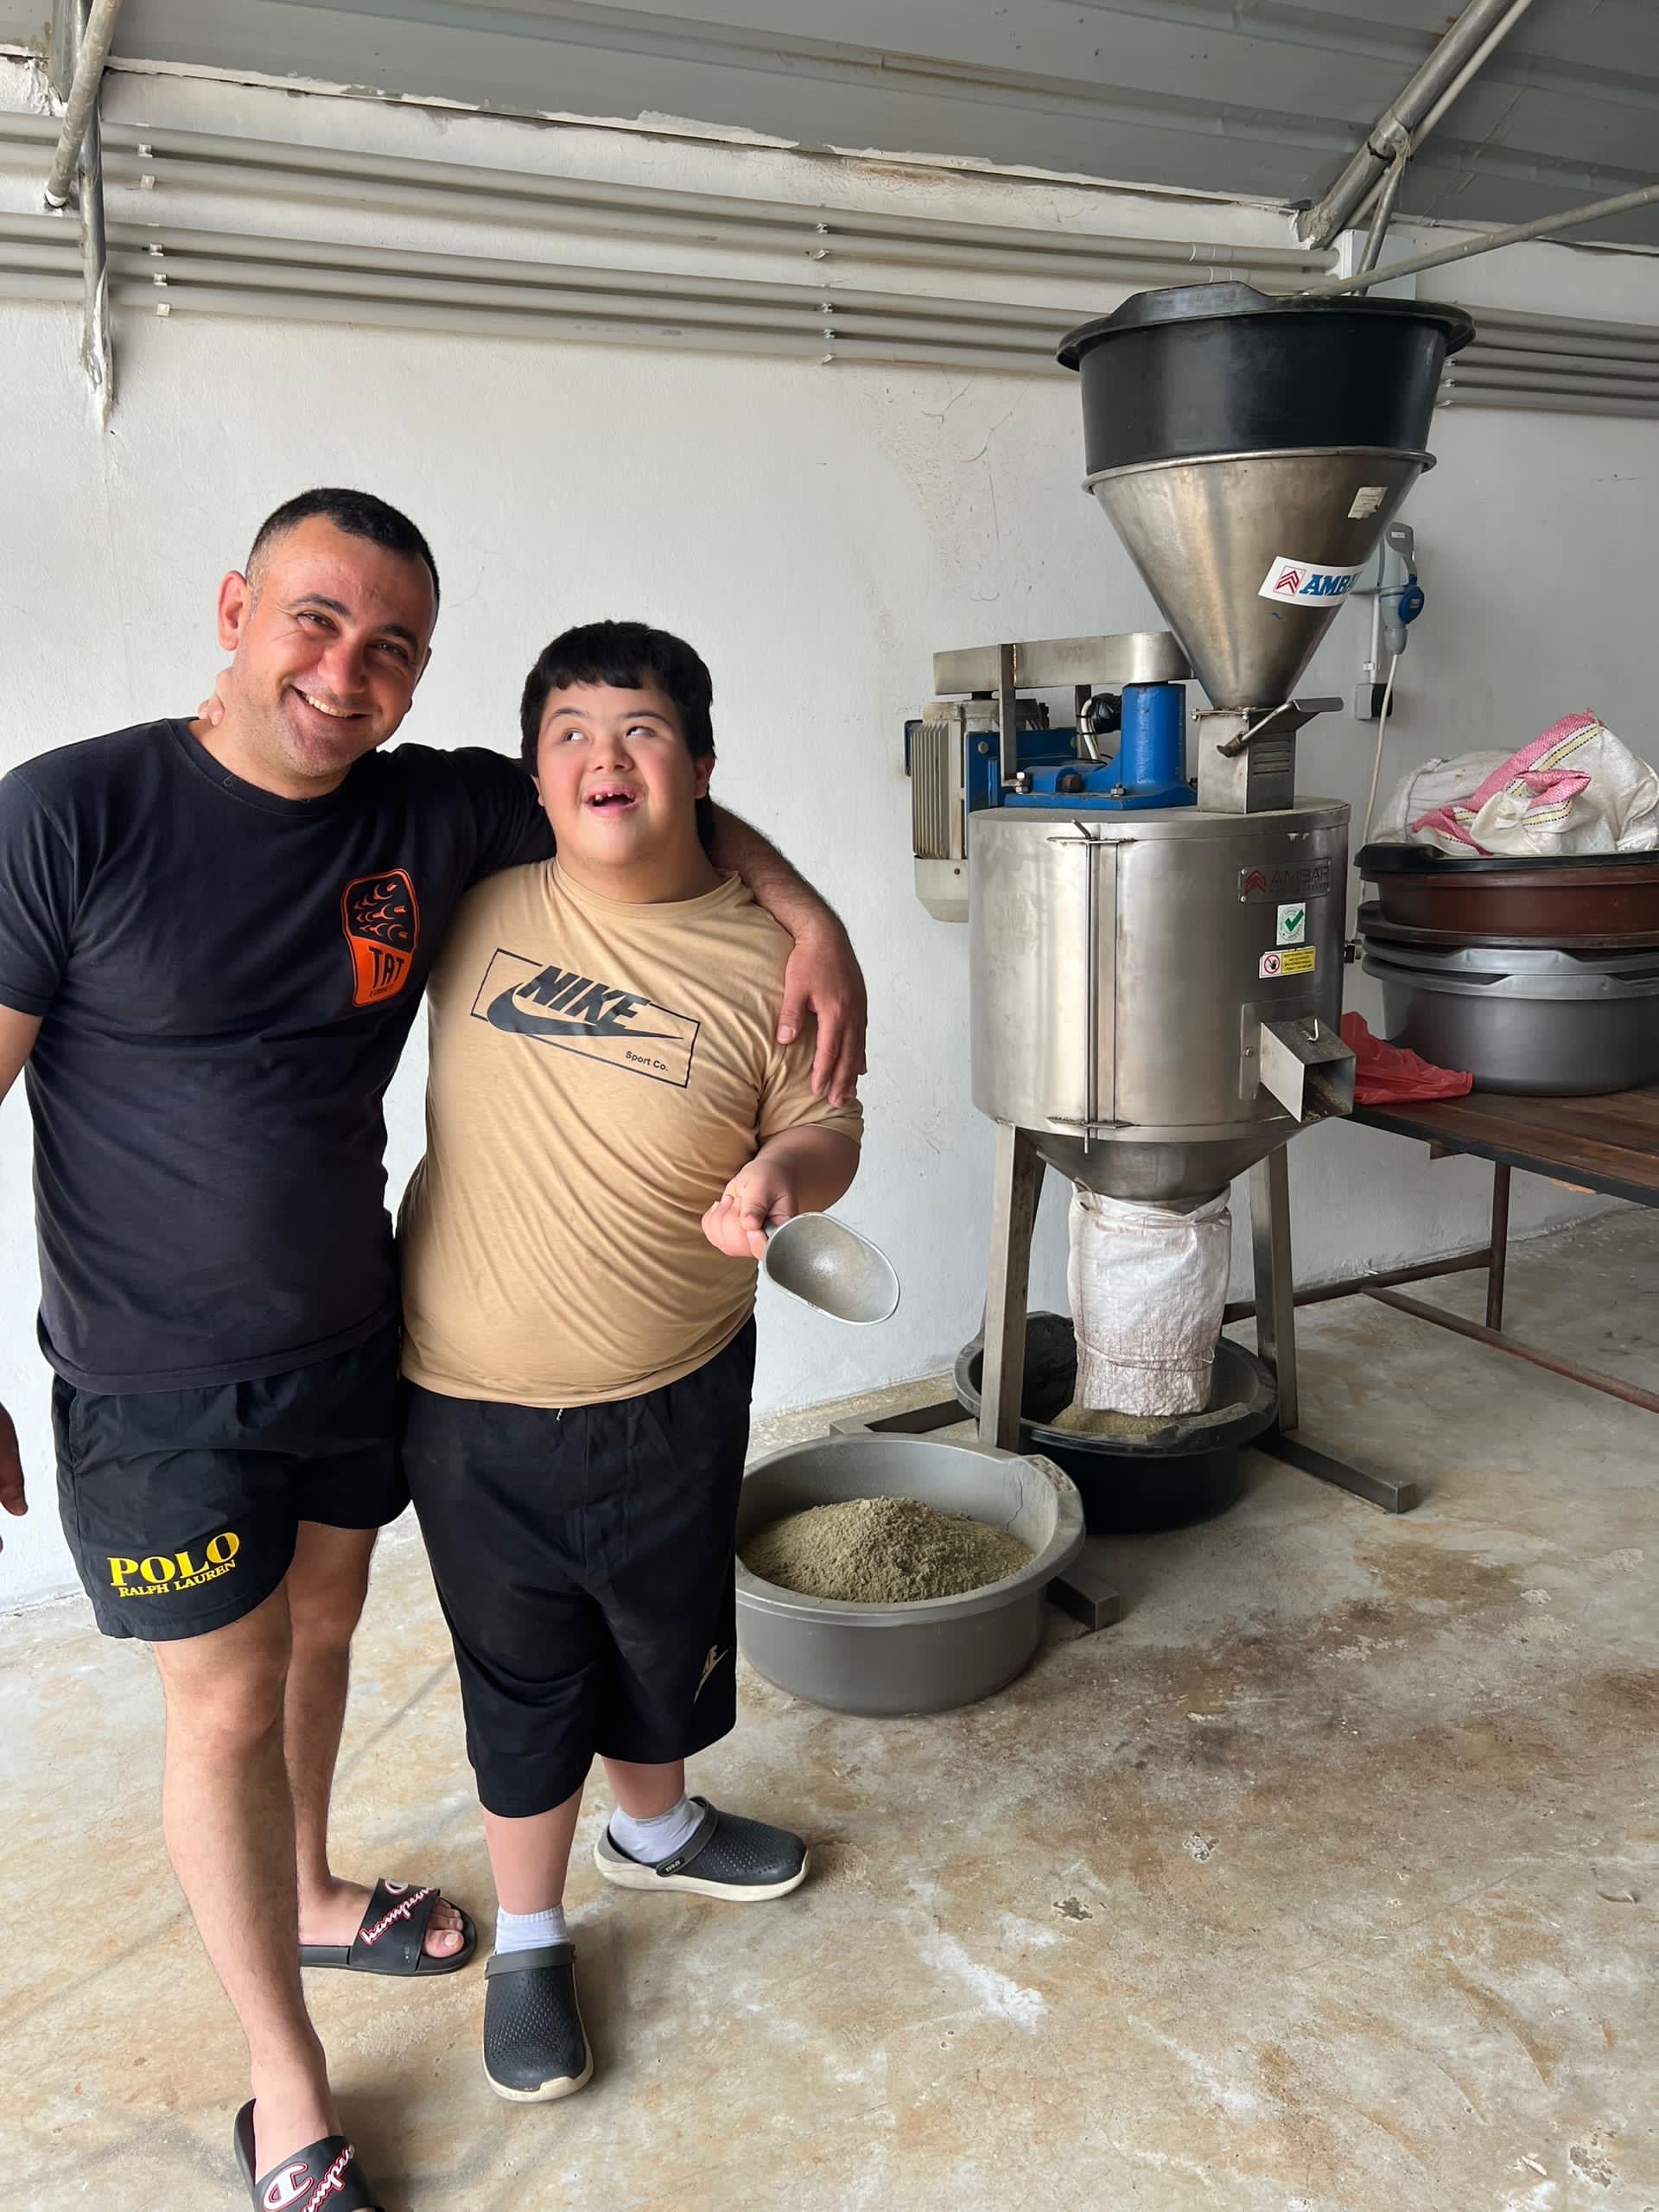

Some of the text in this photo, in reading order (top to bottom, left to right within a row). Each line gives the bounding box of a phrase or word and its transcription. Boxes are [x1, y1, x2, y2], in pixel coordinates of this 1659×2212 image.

[368, 945, 405, 988] TAT
[516, 964, 652, 1029] NIKE
[625, 1051, 670, 1072] Sport Co.
[106, 1531, 241, 1587] POLO
[118, 1559, 237, 1598] RALPH LAUREN
